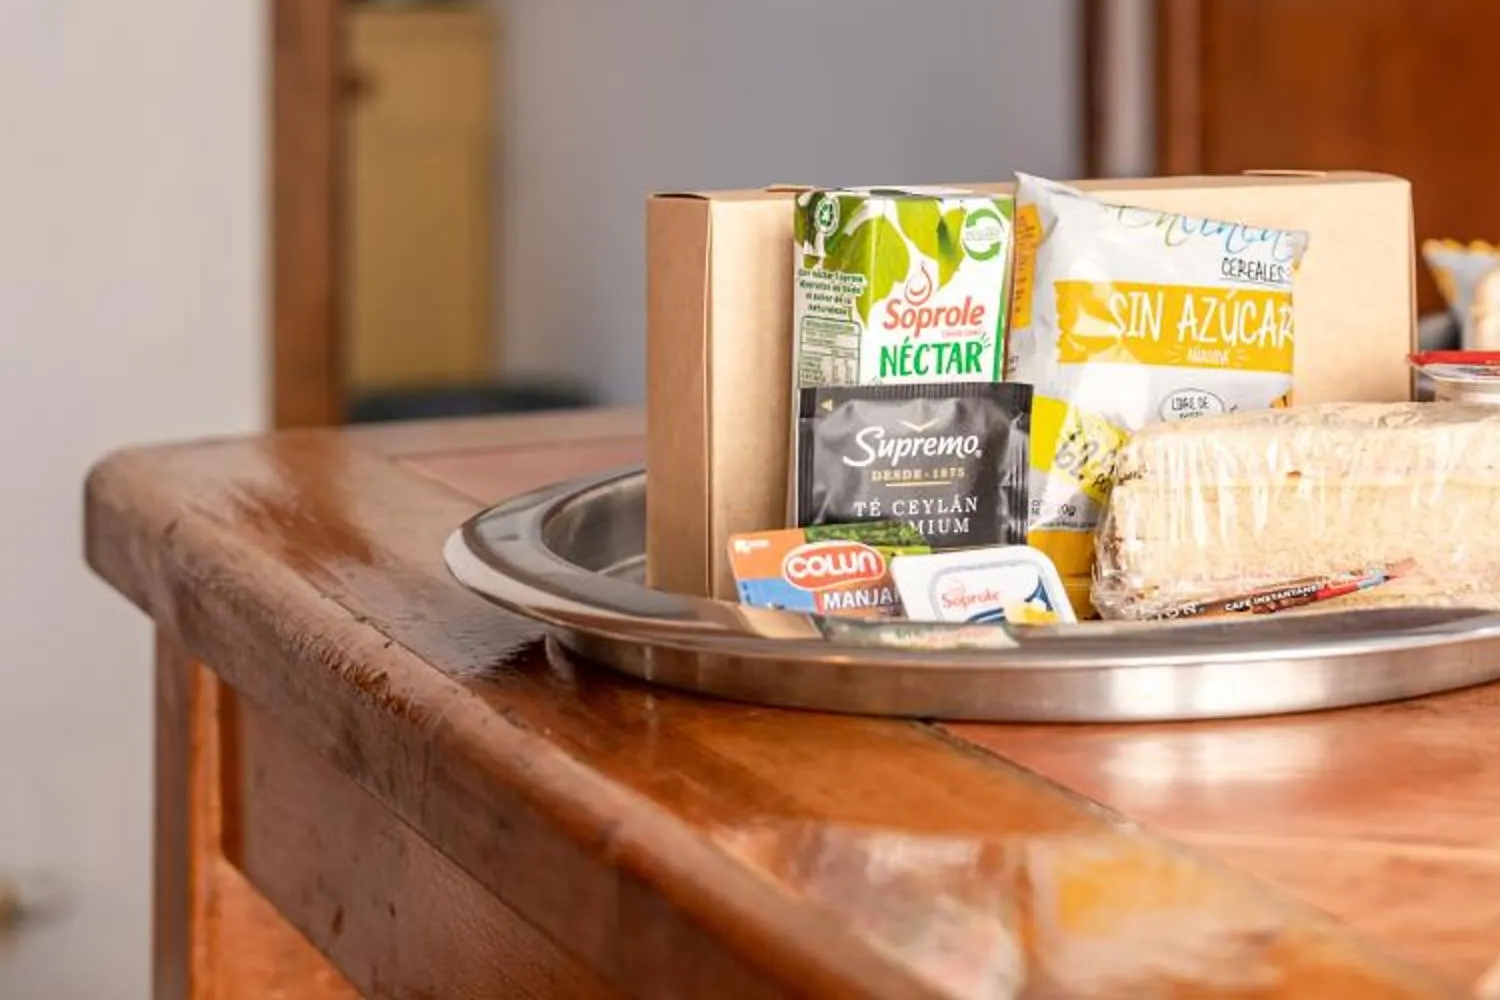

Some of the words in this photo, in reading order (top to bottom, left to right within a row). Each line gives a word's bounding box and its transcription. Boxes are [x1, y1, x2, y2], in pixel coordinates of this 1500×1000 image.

[1221, 256, 1285, 282] CEREALES
[883, 295, 985, 338] Soprole
[1109, 292, 1164, 342] SIN
[1177, 289, 1293, 349] AZÚCAR
[879, 336, 984, 378] NÉCTAR
[842, 425, 979, 467] Supremo
[854, 497, 881, 518] TÉ
[893, 494, 978, 516] CEYLÁN
[788, 550, 878, 579] COLUN
